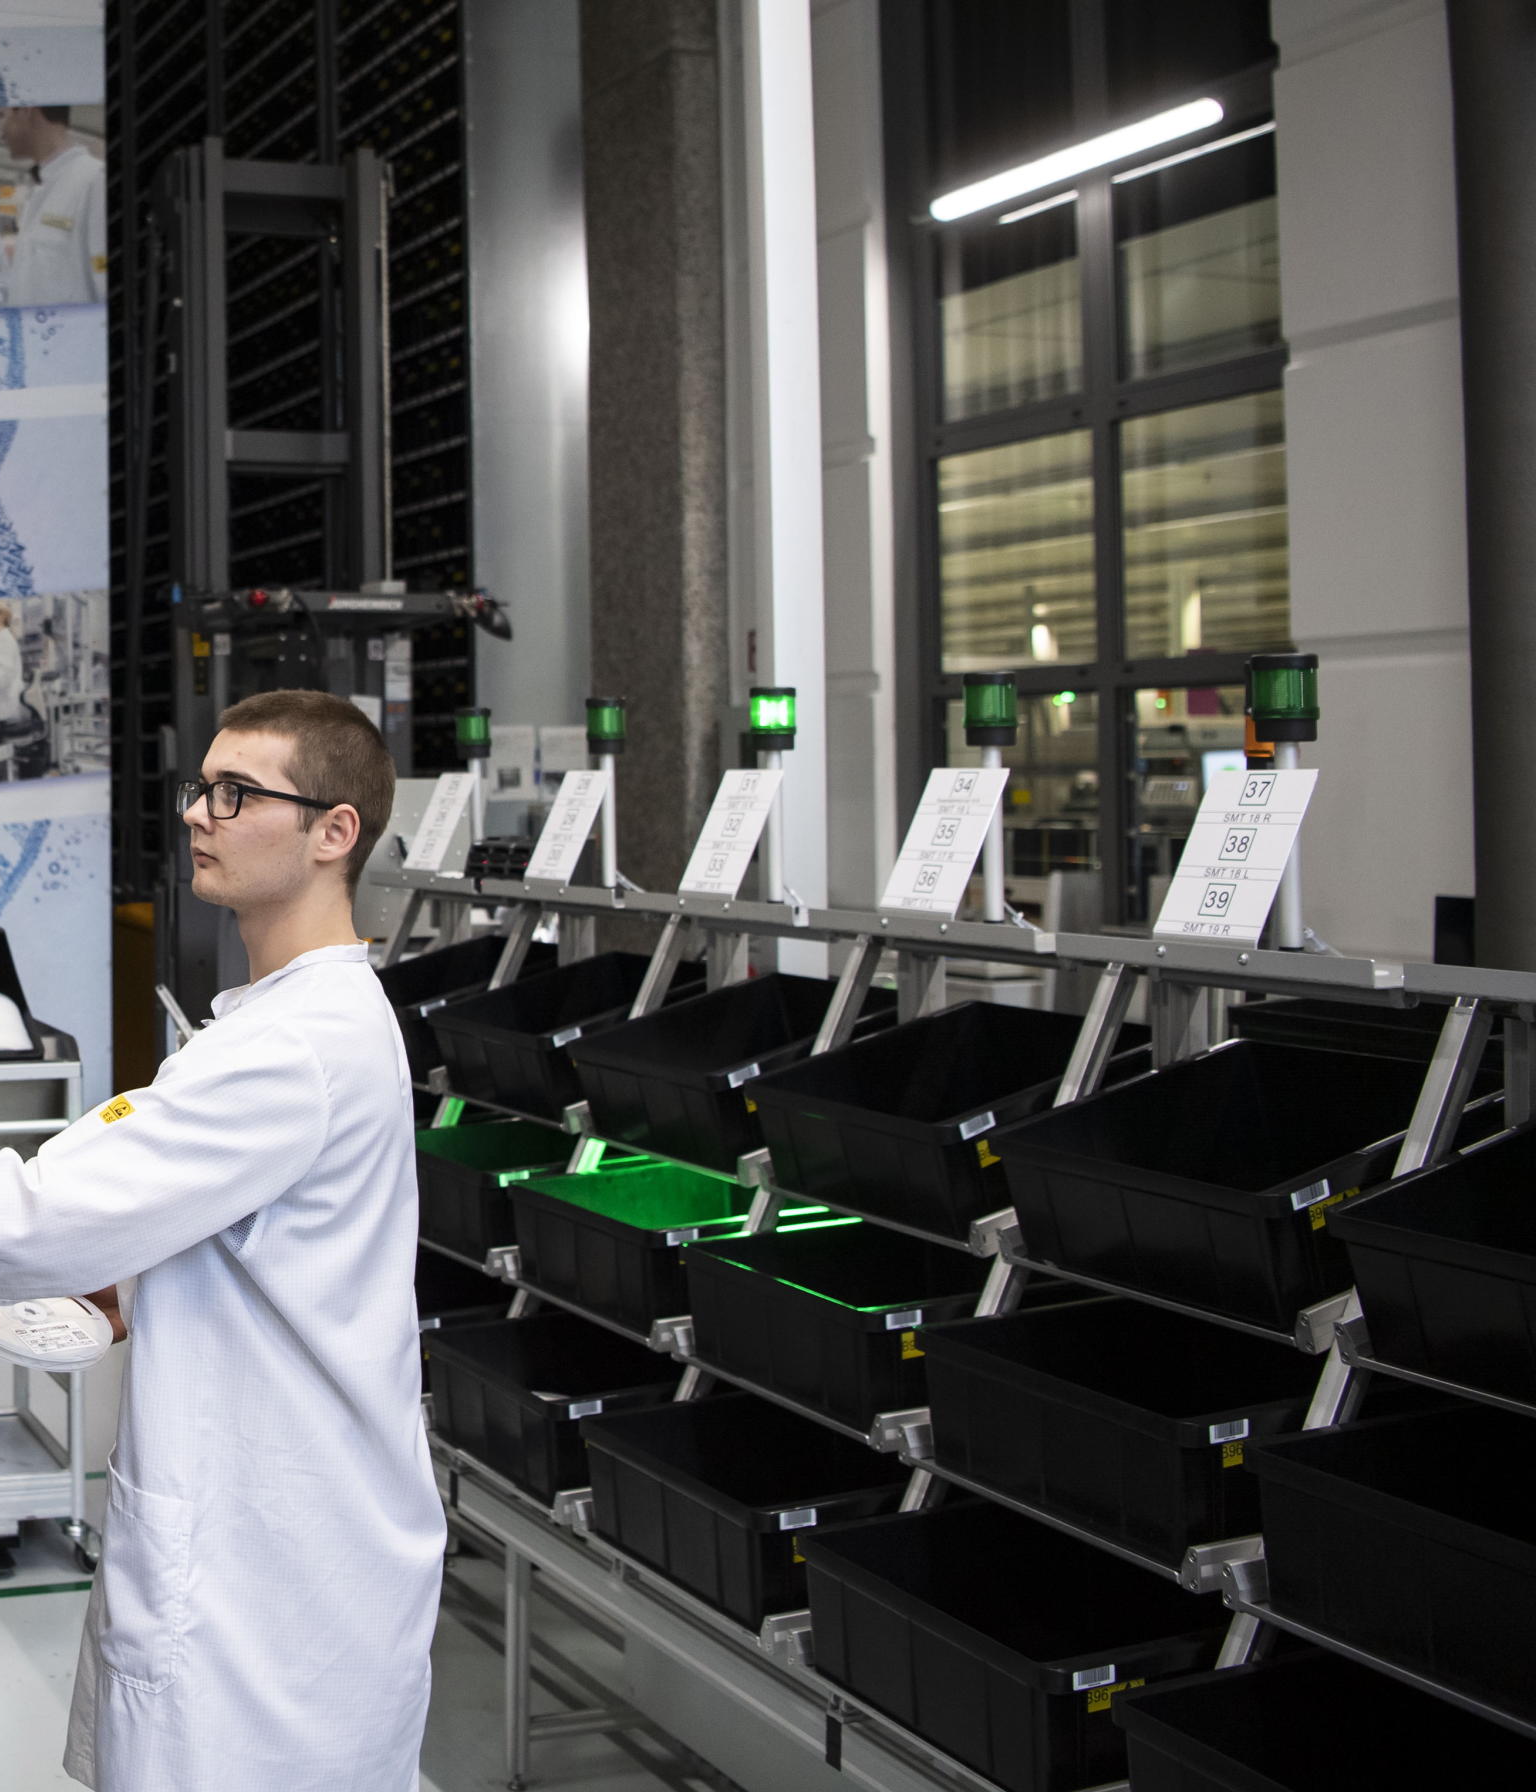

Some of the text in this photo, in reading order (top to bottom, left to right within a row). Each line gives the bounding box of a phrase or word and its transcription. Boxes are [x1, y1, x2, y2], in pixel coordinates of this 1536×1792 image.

[954, 778, 973, 793] 34
[1245, 781, 1271, 798] 37
[1224, 813, 1272, 823] SMT 18 R
[936, 824, 955, 840] 35
[1225, 835, 1250, 853] 38
[918, 871, 937, 887] 36
[1203, 868, 1250, 879] SMT 18 L
[1205, 890, 1230, 909] 39
[1182, 922, 1231, 935] SMT 19 R
